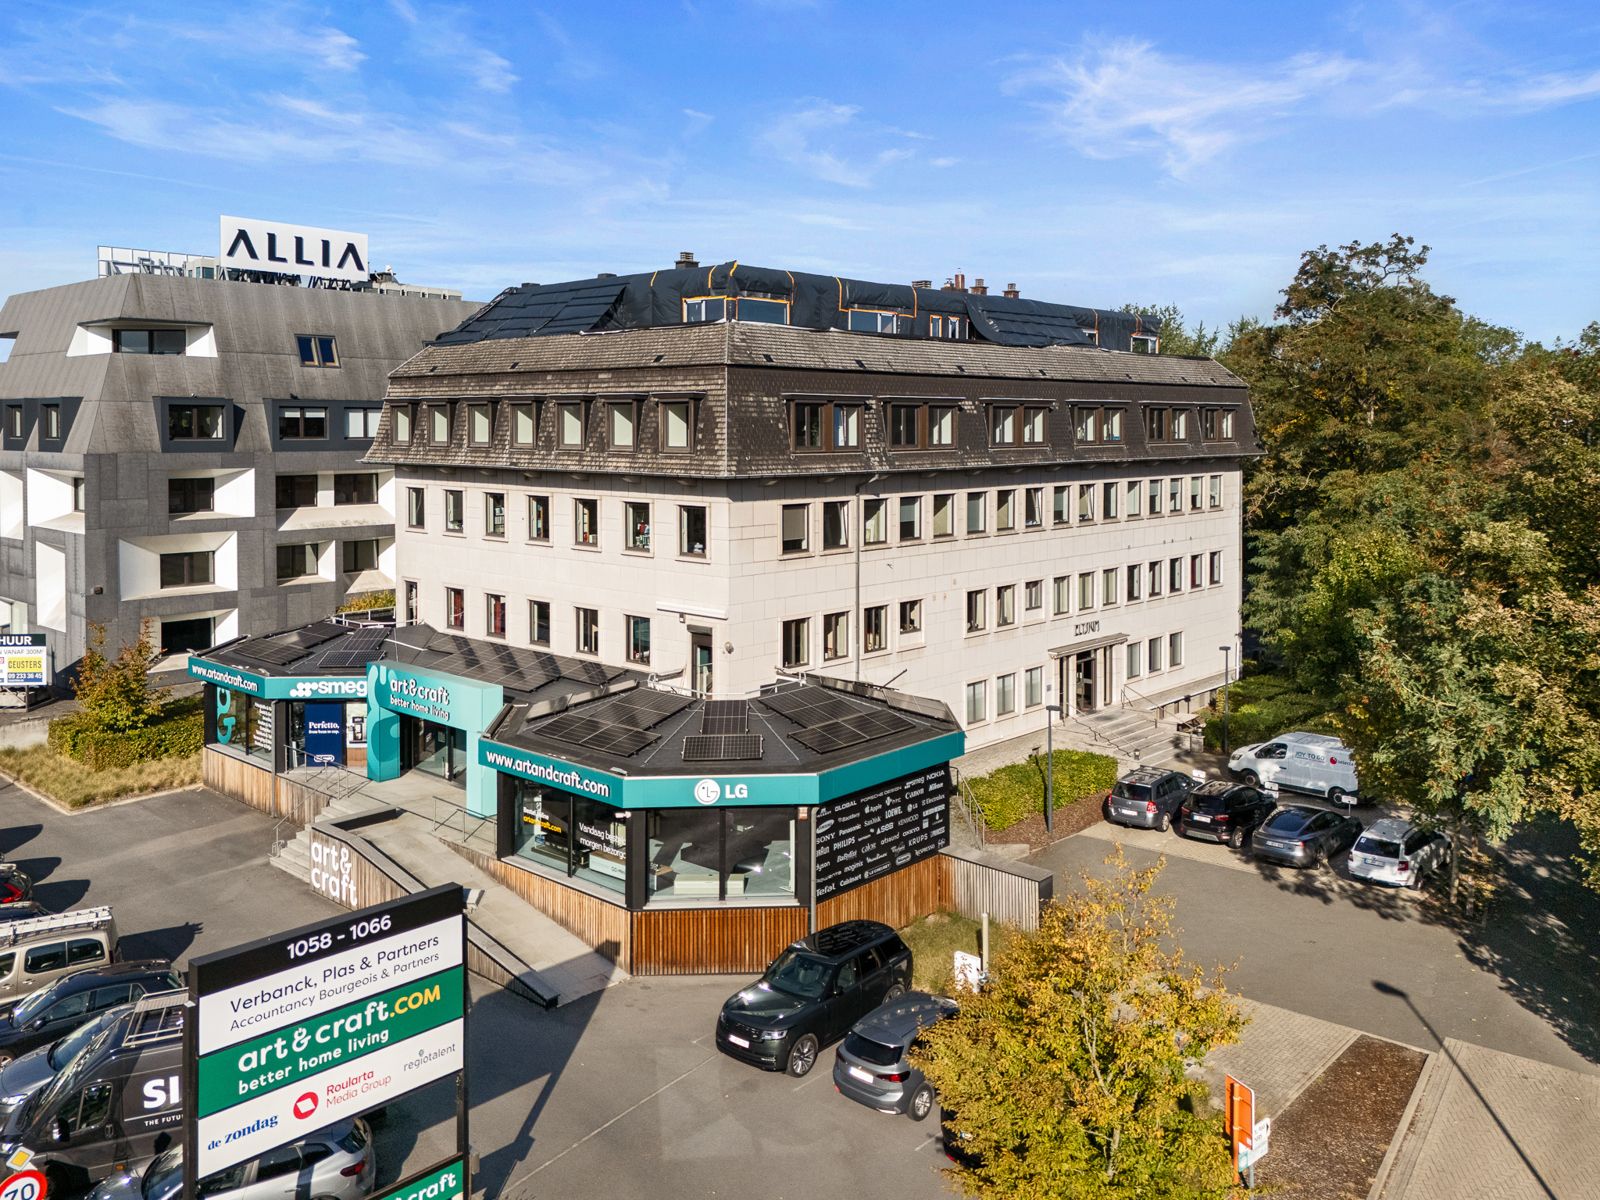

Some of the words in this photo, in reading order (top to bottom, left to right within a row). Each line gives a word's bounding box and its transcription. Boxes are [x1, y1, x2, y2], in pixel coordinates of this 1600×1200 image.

[227, 229, 365, 271] ALLIA
[8, 660, 42, 669] GEUSTERS
[192, 664, 258, 692] www.artandcraft.com
[317, 680, 368, 697] smeg
[390, 694, 410, 708] better
[411, 700, 429, 713] home
[431, 704, 450, 720] living
[486, 751, 610, 797] www.artandcraft.com
[926, 770, 945, 781] NOKIA
[725, 783, 748, 799] LG
[905, 788, 924, 800] Canon
[579, 822, 605, 840] Vandaag
[580, 837, 603, 851] morgen
[816, 833, 835, 845] SONY
[834, 836, 855, 851] PHILIPS
[909, 834, 928, 847] KRUPS
[311, 842, 352, 874] art&
[311, 867, 358, 906] craft
[817, 882, 836, 898] Tefal
[286, 932, 332, 960] 1058
[350, 915, 392, 941] 1066
[230, 975, 318, 1014] Verbanck,
[323, 963, 355, 983] Plas
[360, 956, 372, 970] &
[377, 935, 439, 965] Partners
[230, 993, 316, 1031] Accountancy
[319, 973, 378, 1000] Bourgeois
[381, 969, 390, 978] &
[393, 952, 439, 975] Partners
[238, 1065, 292, 1095] better
[299, 1050, 342, 1073] home
[348, 1027, 389, 1053] living
[403, 1043, 456, 1072] regiotalent
[326, 1069, 375, 1096] Roularta
[326, 1088, 358, 1109] Media
[361, 1073, 392, 1096] Group
[144, 1118, 159, 1127] THE
[207, 1137, 222, 1151] de
[224, 1114, 279, 1145] zondag
[4, 1183, 35, 1200] 70
